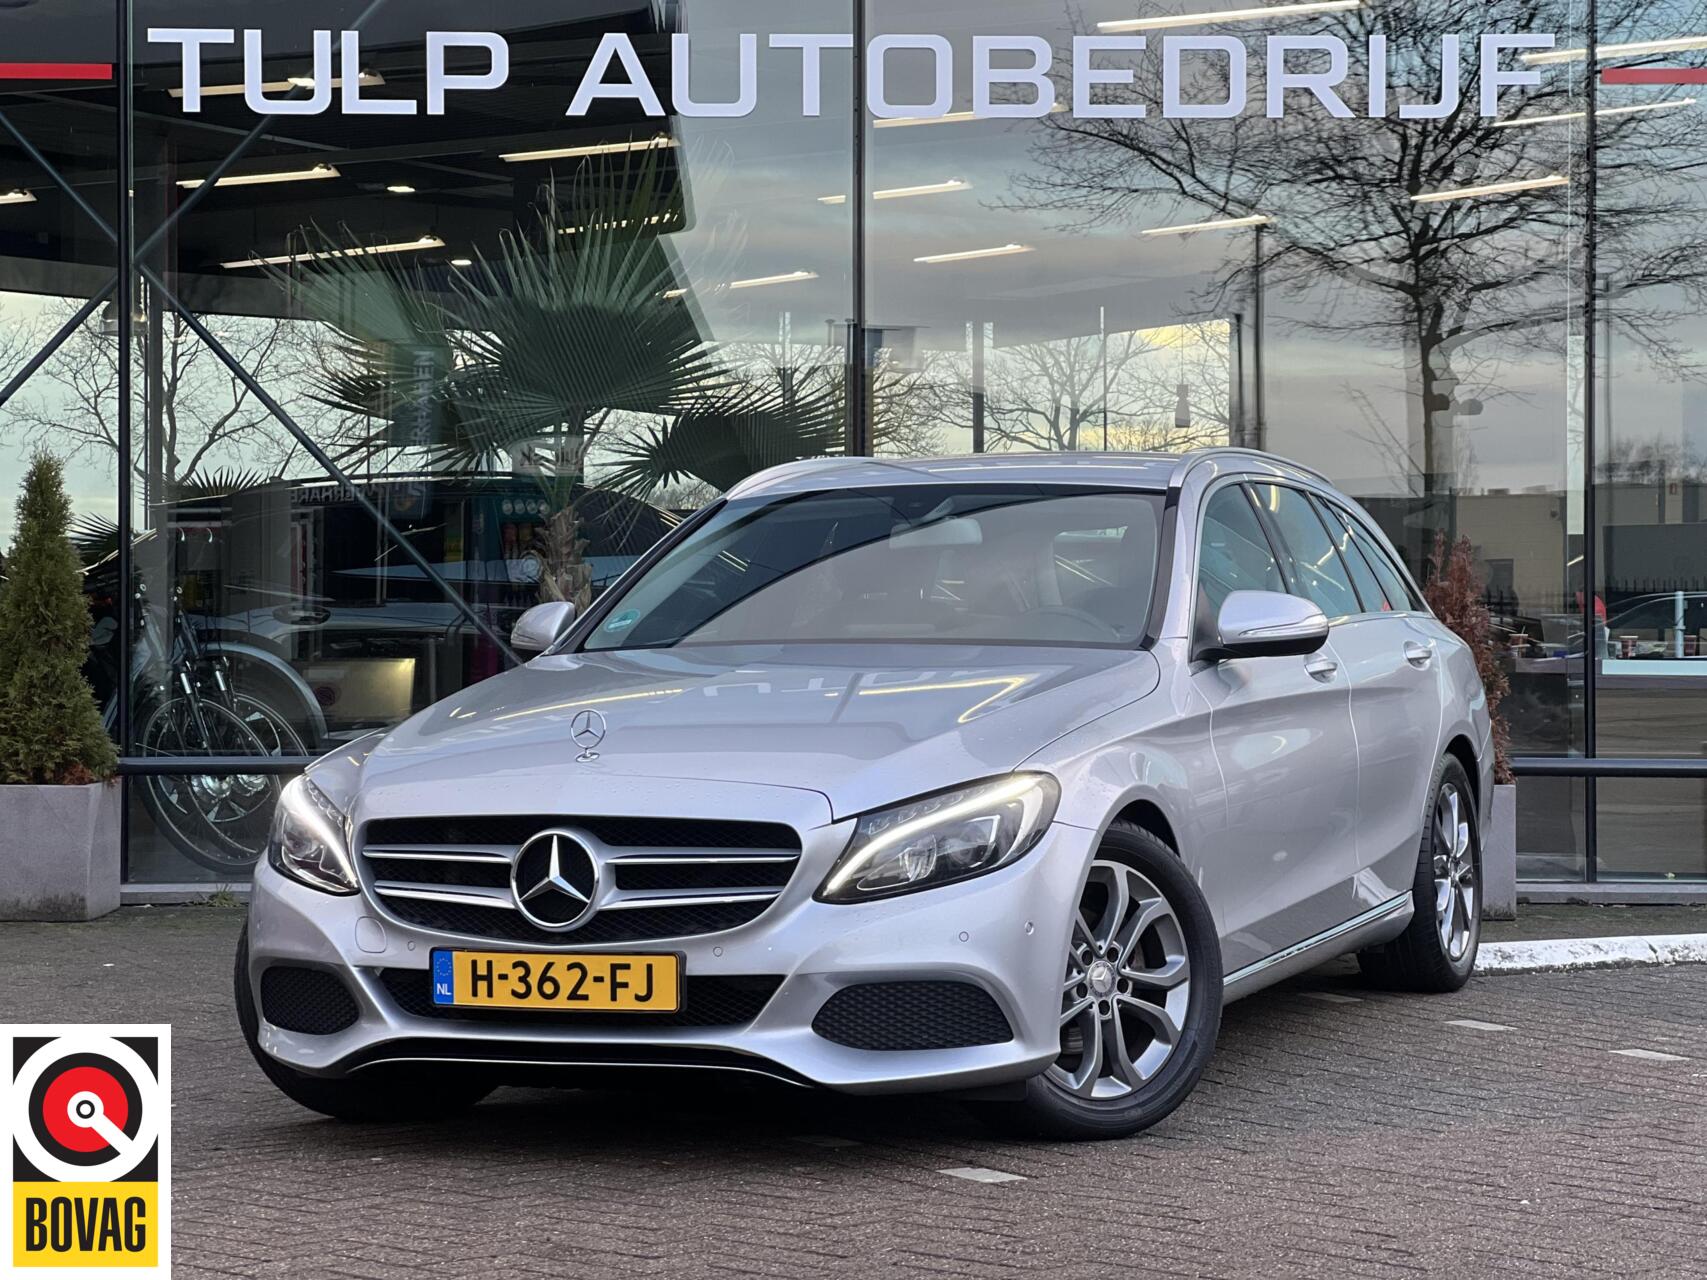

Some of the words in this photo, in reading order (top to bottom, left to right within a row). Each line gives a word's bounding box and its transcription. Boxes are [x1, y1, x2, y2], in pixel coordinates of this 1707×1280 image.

[147, 28, 510, 116] TULP
[566, 32, 1556, 119] AUTOBEDRIJF
[436, 982, 452, 996] NL
[471, 959, 653, 1002] H-362-FJ
